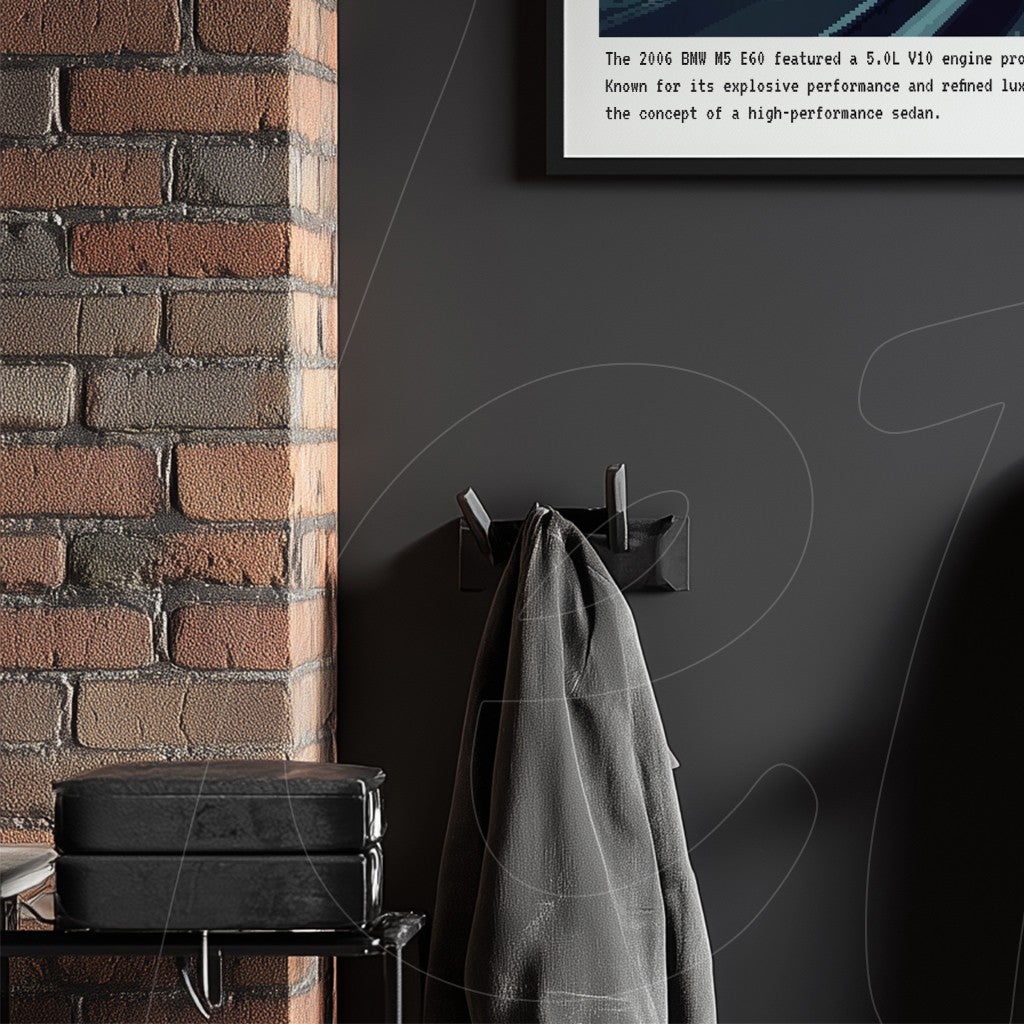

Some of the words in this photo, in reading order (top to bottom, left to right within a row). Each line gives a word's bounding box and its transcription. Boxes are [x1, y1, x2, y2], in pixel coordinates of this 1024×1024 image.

[605, 51, 631, 66] The
[639, 51, 673, 66] 2006
[681, 51, 707, 66] BMW
[714, 51, 732, 66] M5
[740, 51, 765, 66] E60
[774, 51, 841, 66] featured
[849, 54, 858, 66] a
[866, 50, 900, 66] 5.0L
[908, 50, 933, 66] V10
[941, 50, 993, 69] engine
[605, 78, 648, 93] Known
[656, 78, 681, 93] for
[690, 78, 714, 93] its
[723, 78, 799, 97] explosive
[807, 78, 900, 97] performance
[908, 78, 934, 93] and
[941, 78, 993, 92] refined
[605, 106, 631, 120] the
[638, 106, 697, 124] concept
[706, 106, 722, 120] of
[731, 109, 740, 120] a
[748, 106, 883, 124] high-performance
[891, 105, 940, 120] sedan.
